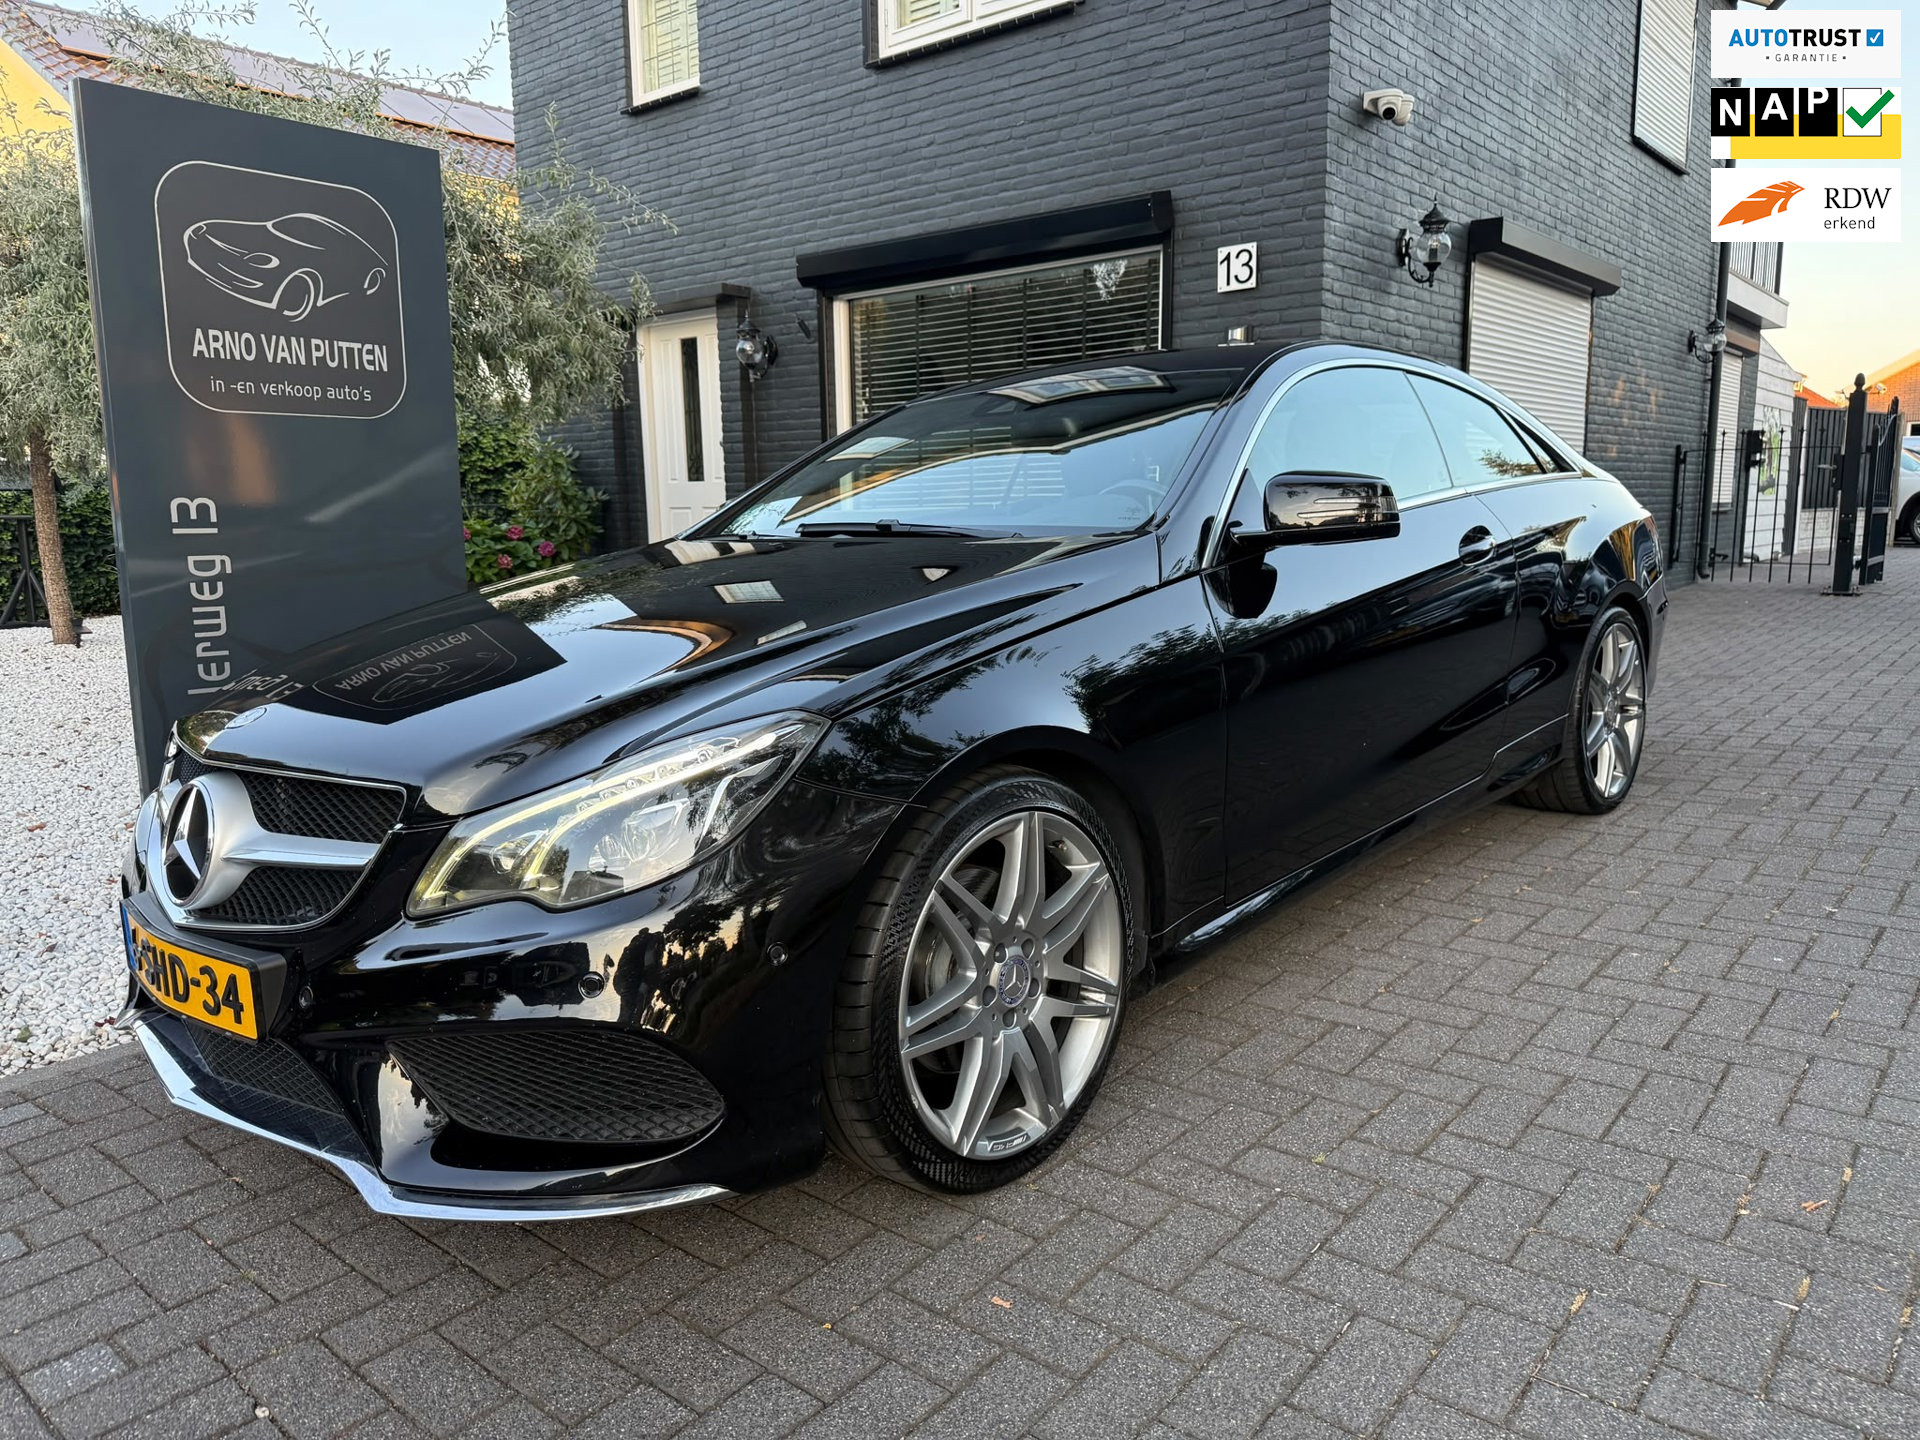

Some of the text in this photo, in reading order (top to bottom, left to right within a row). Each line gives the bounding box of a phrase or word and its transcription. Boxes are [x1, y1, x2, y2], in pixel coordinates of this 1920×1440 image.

[1219, 248, 1254, 287] 13
[192, 327, 388, 372] ARNO VAN PUTTEN
[210, 376, 372, 401] in -en verkoop auto's
[170, 497, 219, 534] 13
